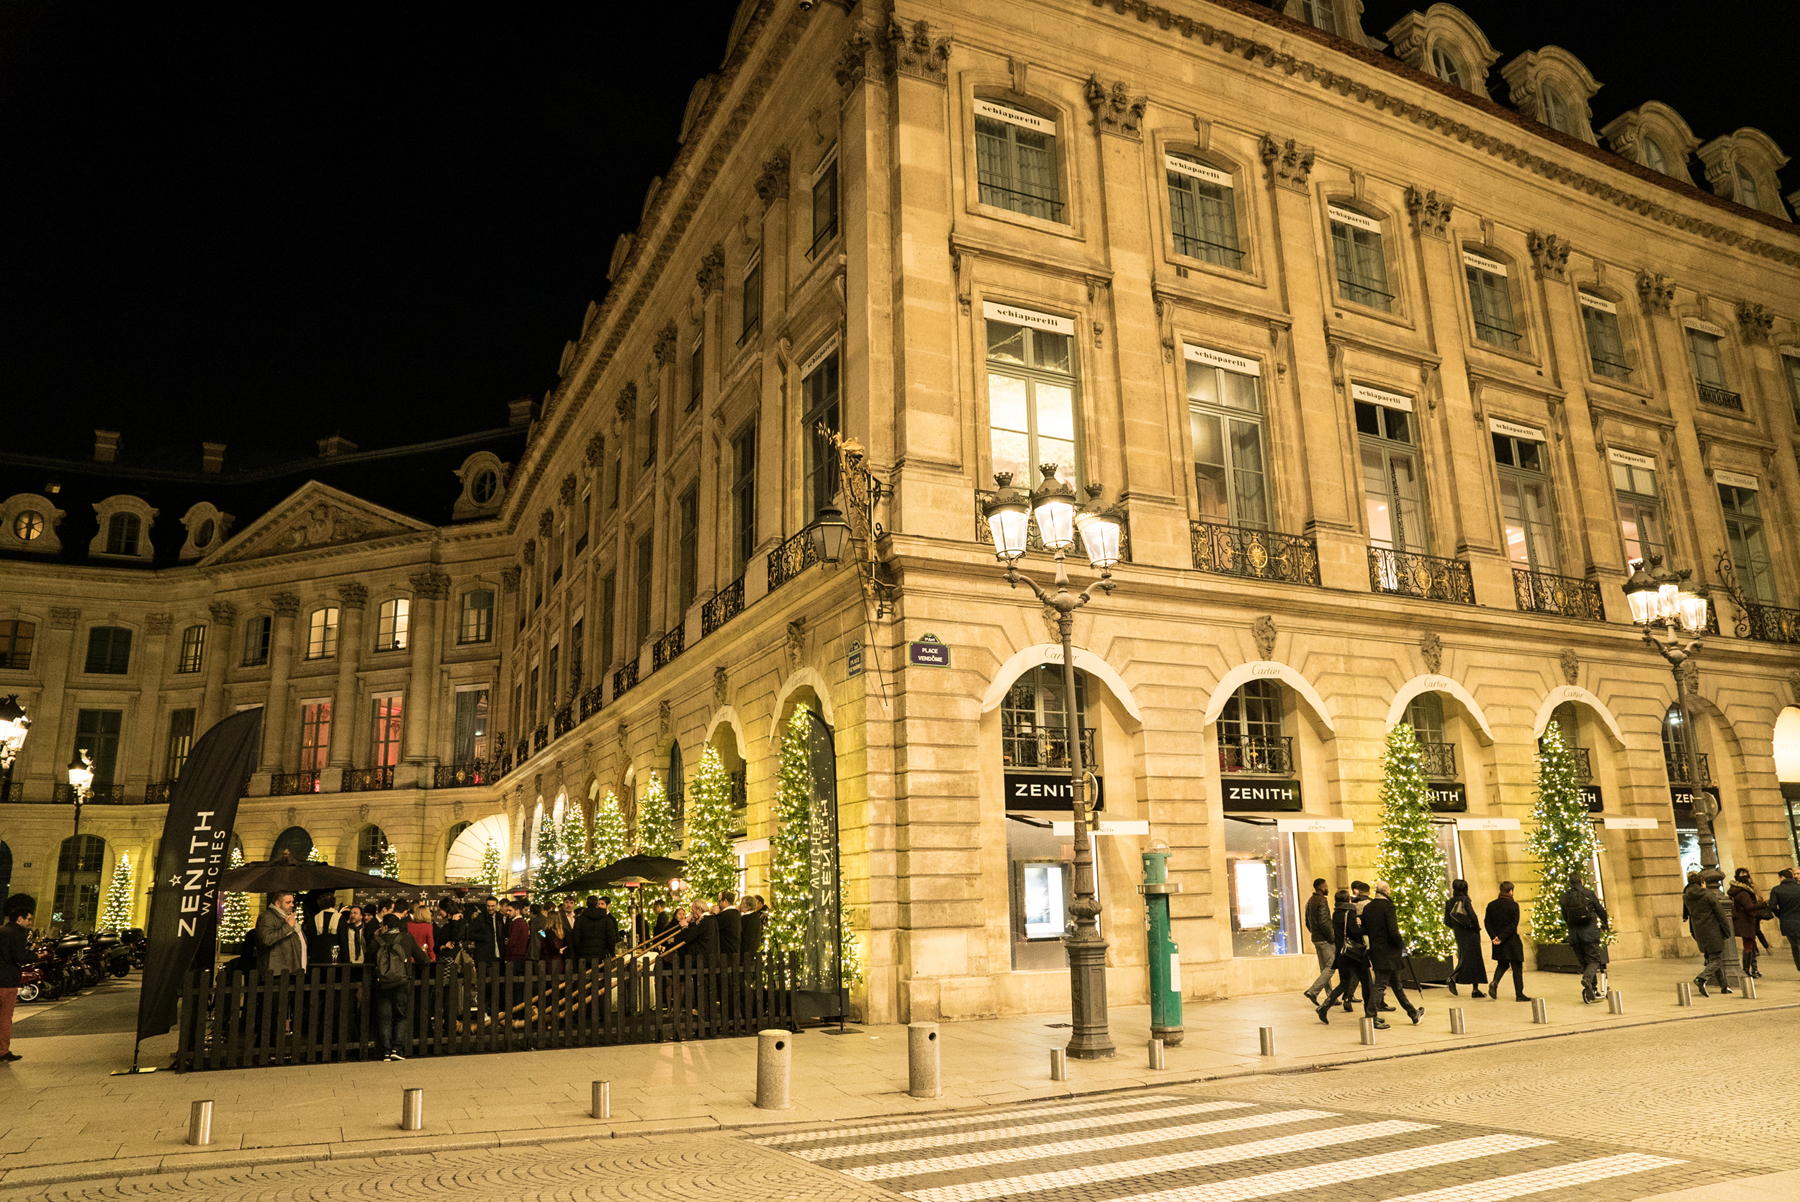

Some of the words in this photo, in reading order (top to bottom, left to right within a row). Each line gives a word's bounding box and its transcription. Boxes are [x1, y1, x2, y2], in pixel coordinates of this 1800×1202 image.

[982, 105, 1041, 127] schiaparelli
[1169, 160, 1220, 179] schiaparelli
[1328, 209, 1370, 226] schiaparelli
[1463, 255, 1498, 270] chiaparelli
[1580, 295, 1608, 308] hiaparelli
[997, 308, 1059, 327] schiaparelli
[1194, 350, 1247, 368] schiaparelli
[1358, 390, 1402, 404] schiaparelli
[1495, 423, 1535, 436] schiaparelli
[1613, 452, 1647, 464] schiaparelli
[917, 655, 943, 663] VENDÔME
[1251, 663, 1281, 676] Cartier
[1424, 676, 1448, 688] Cartier
[1563, 687, 1584, 698] Cartier
[1015, 783, 1074, 797] ZENIT
[1229, 787, 1293, 800] ZENITH
[1424, 790, 1459, 802] NITH
[728, 815, 748, 828] ZENIT
[177, 811, 215, 937] ZENITH
[201, 830, 226, 916] WATCHES
